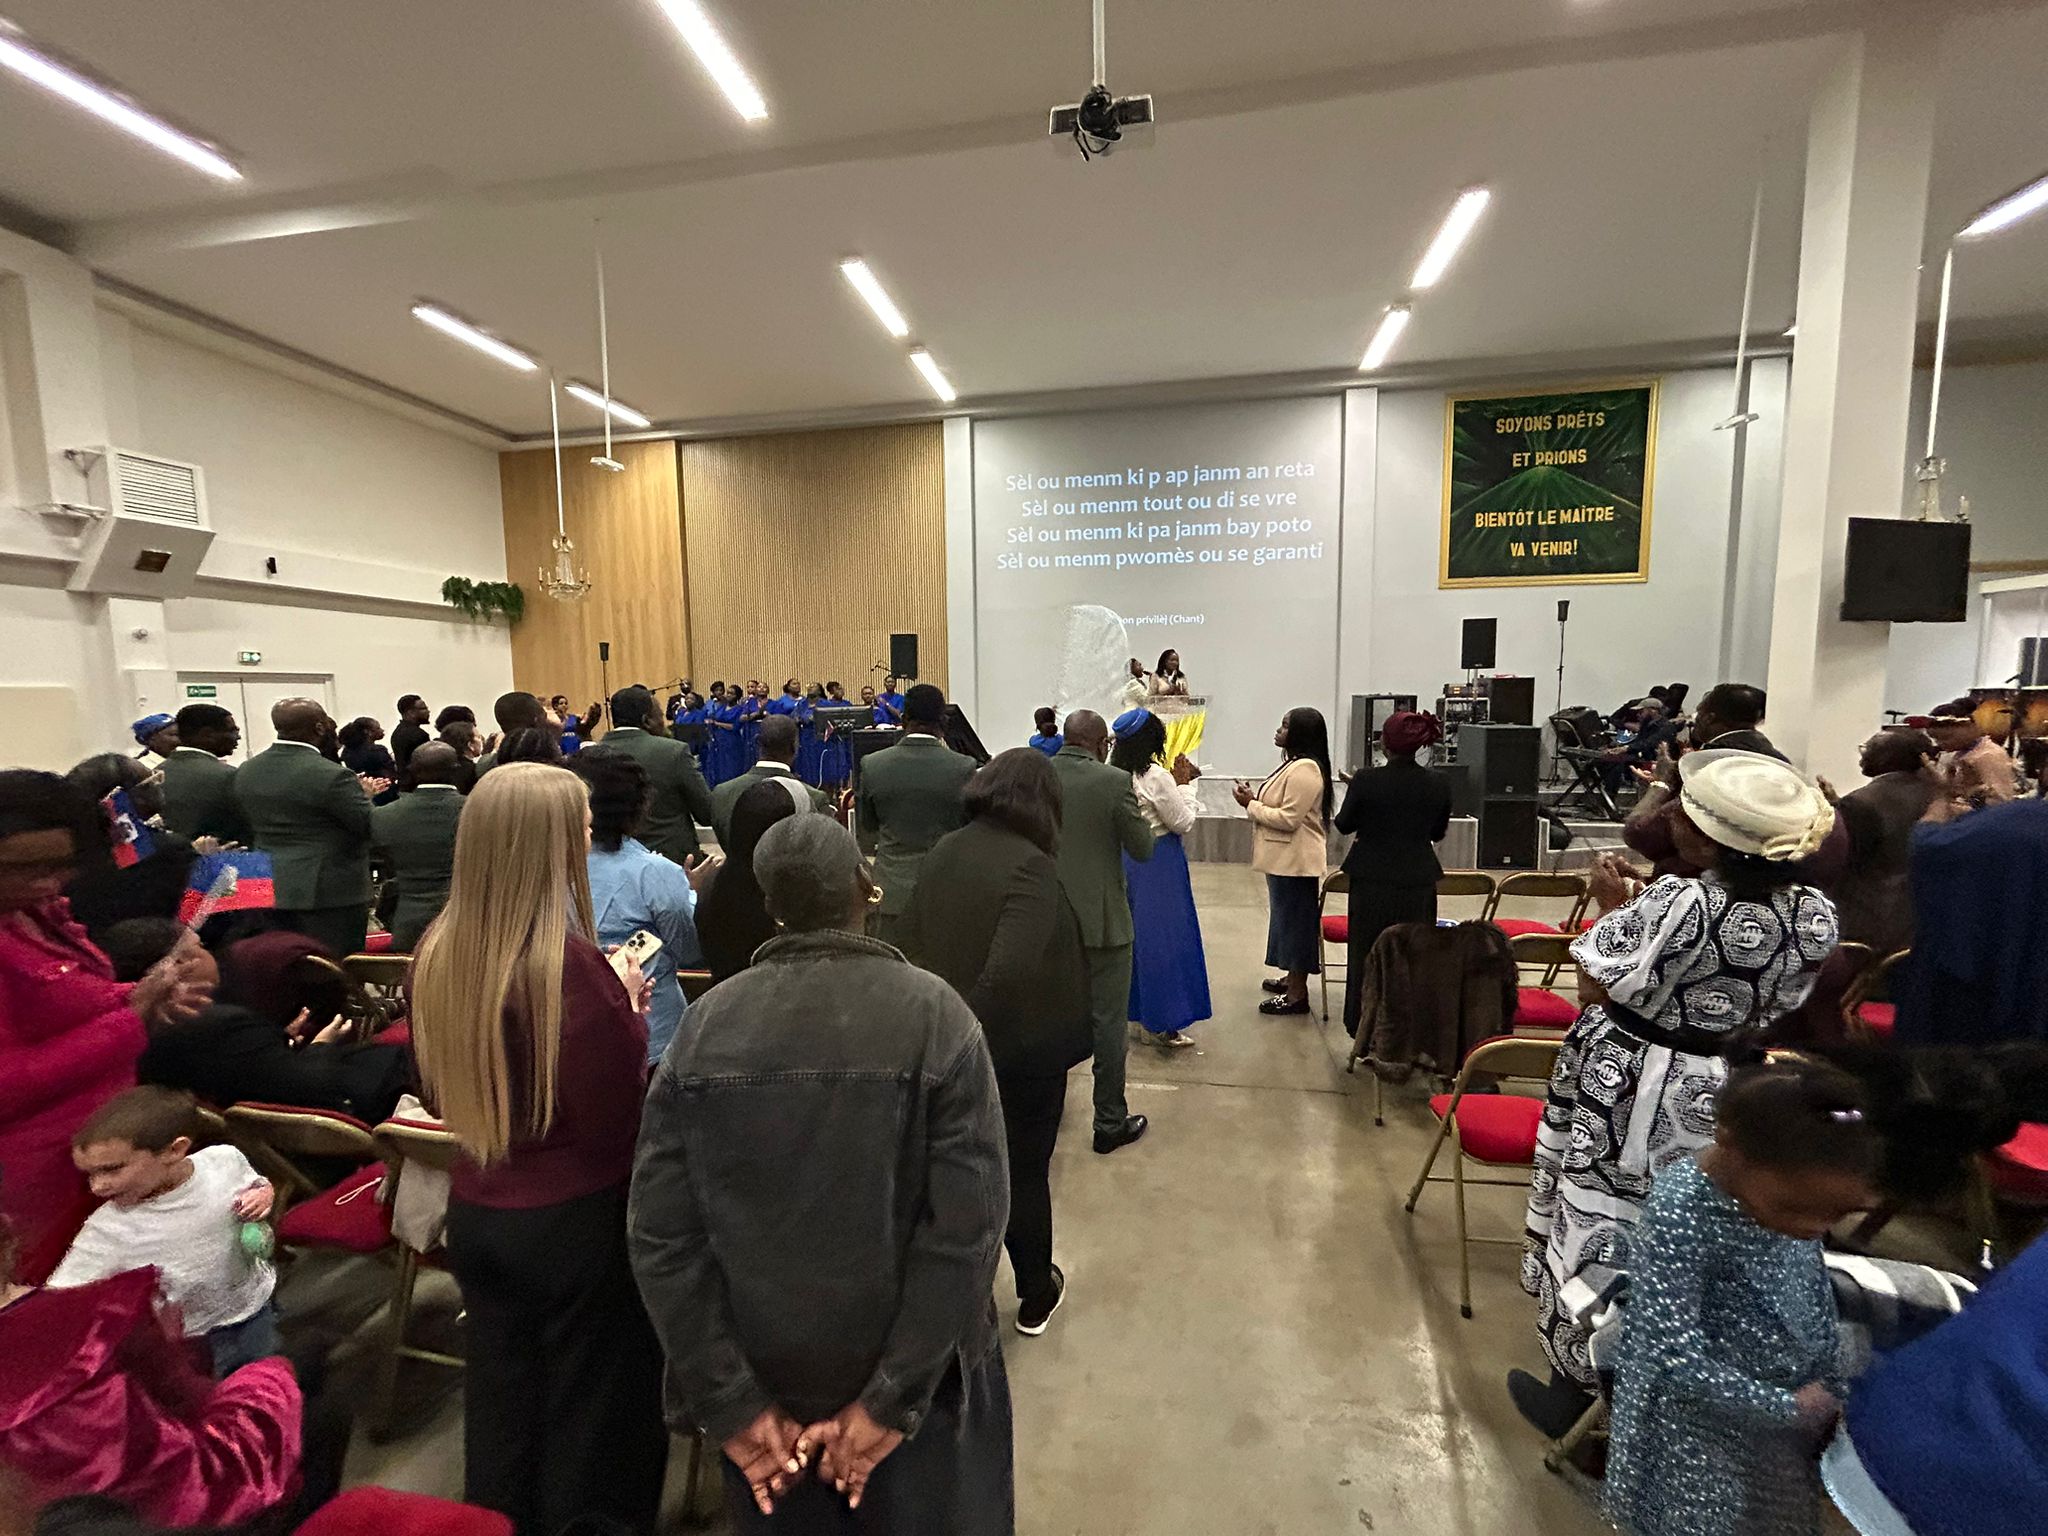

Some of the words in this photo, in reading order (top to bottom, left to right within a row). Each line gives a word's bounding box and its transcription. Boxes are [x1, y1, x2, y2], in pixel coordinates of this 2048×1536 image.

[1496, 415, 1552, 433] SOYONS
[1557, 411, 1605, 428] PRÊTS
[1512, 453, 1530, 467] ET
[1535, 449, 1587, 466] PRIONS
[1006, 474, 1032, 492] Sèl
[1037, 478, 1060, 490] ou
[1065, 473, 1122, 488] menm
[1128, 468, 1144, 485] ki
[1166, 469, 1188, 487] ap
[1193, 465, 1241, 486] janm
[1246, 465, 1269, 479] an
[1275, 461, 1315, 478] reta
[1022, 501, 1048, 517] Sèl
[1053, 503, 1076, 515] ou
[1080, 499, 1138, 513] menm
[1143, 494, 1183, 511] tout
[1187, 496, 1211, 509] ou
[1216, 491, 1235, 508] di
[1239, 493, 1260, 507] se
[1265, 491, 1297, 505] vre
[1475, 509, 1533, 528] BIENTÔT
[1538, 510, 1556, 525] LE
[1559, 505, 1614, 523] MAÎTRE
[1007, 527, 1033, 543] Sèl
[1038, 530, 1061, 542] ou
[1065, 526, 1122, 541] menm
[1127, 521, 1143, 538] ki
[1148, 523, 1171, 542] pa
[1175, 520, 1222, 540] janm
[1227, 517, 1260, 537] bay
[1265, 516, 1313, 536] poto
[997, 553, 1023, 570] Sèl
[1027, 556, 1050, 568] ou
[1054, 552, 1111, 567] menm
[1115, 546, 1194, 569] pwomès
[1199, 548, 1223, 562] ou
[1227, 547, 1249, 562] se
[1253, 542, 1323, 566] garanti
[1510, 542, 1525, 556] VA
[1531, 539, 1578, 556] VENIR!
[1169, 613, 1205, 625] (Chant)
